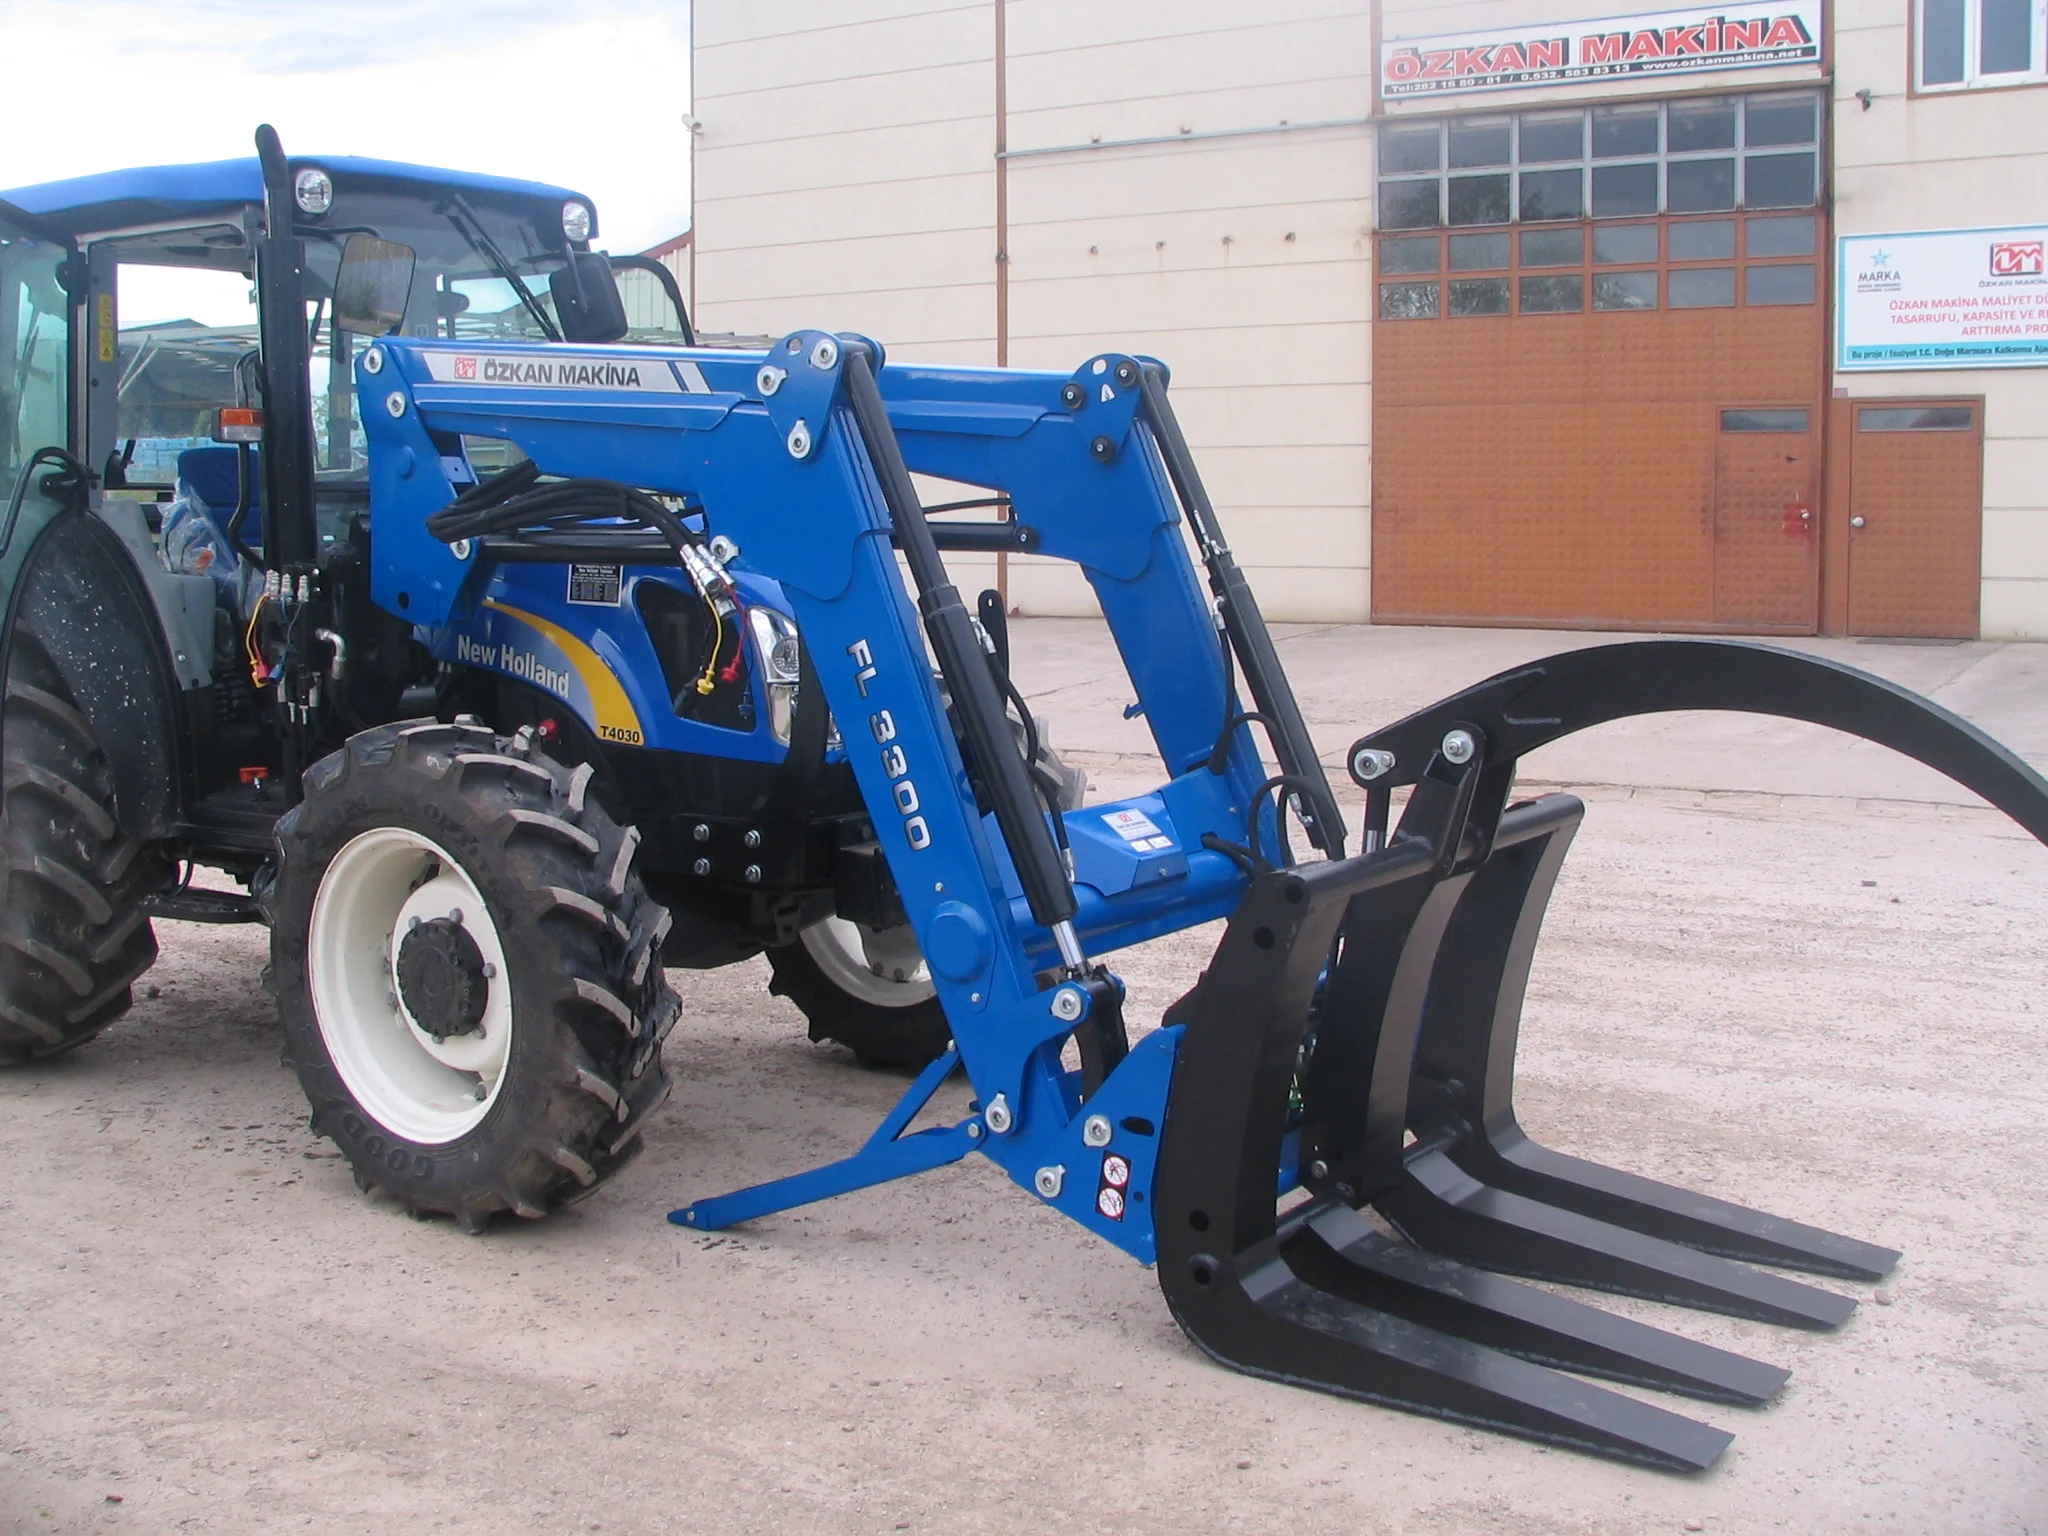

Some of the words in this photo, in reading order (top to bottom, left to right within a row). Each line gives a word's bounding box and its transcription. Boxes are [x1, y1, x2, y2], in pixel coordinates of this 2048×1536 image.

[1385, 38, 1569, 81] ÖZKAN
[1580, 15, 1812, 65] MAKİNA
[1858, 271, 1901, 282] MARKA
[1889, 299, 1928, 310] ÖZKAN
[1931, 296, 1979, 308] MAKİNA
[1982, 294, 2032, 307] MALİYET
[1891, 312, 1960, 325] TASARRUFU,
[1963, 309, 2017, 321] KAPASİTE
[2019, 309, 2035, 319] VE
[1961, 325, 2022, 336] ARTTIRMA
[484, 357, 552, 383] ÖZKAN
[558, 361, 641, 387] MAKİNA
[457, 634, 497, 666] New
[501, 643, 570, 699] Holland
[600, 725, 640, 743] T4030
[846, 638, 878, 699] FL
[869, 708, 932, 851] 3300
